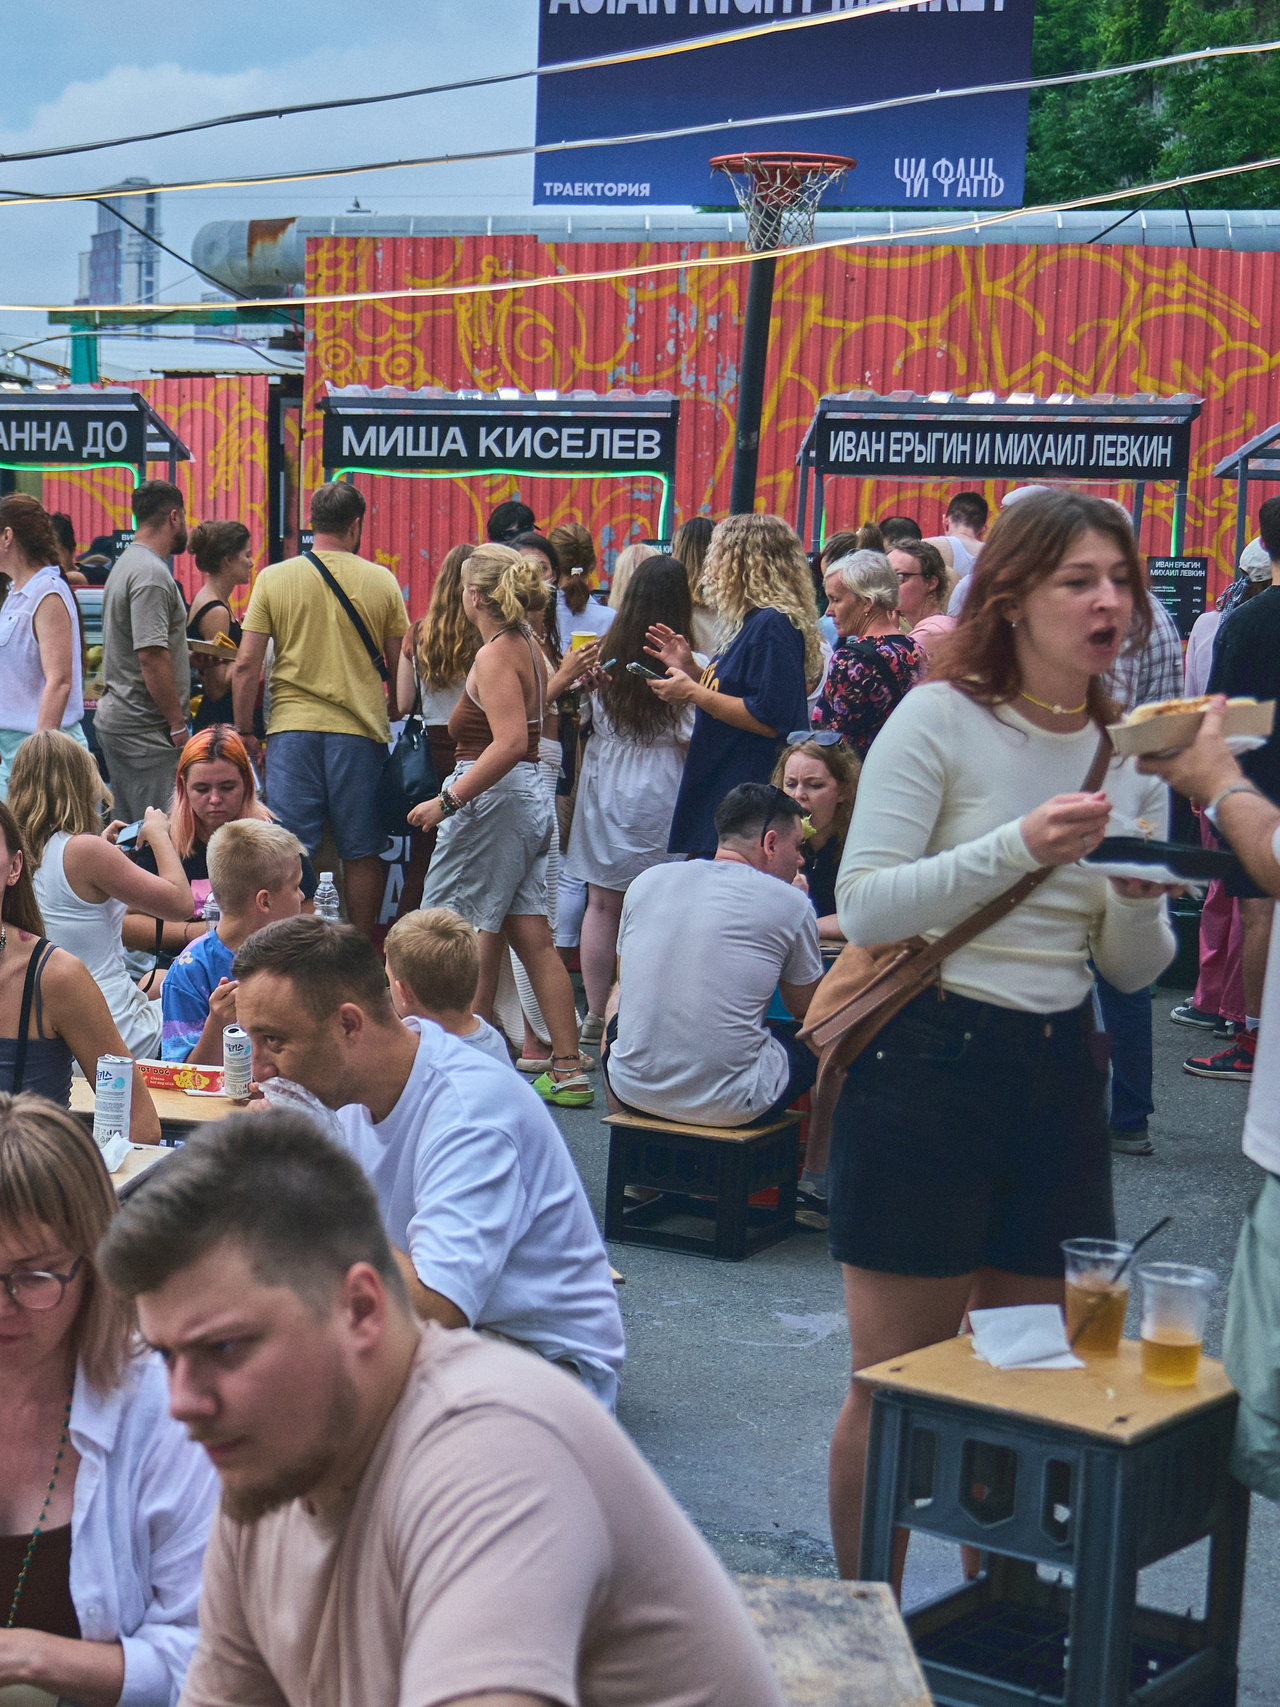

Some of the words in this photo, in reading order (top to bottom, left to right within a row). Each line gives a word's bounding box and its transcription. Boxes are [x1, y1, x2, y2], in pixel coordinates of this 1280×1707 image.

[543, 182, 651, 198] ТРАЕКТОРИЯ
[81, 421, 128, 458] ДО
[342, 425, 468, 457] МИША
[478, 426, 662, 460] КИСЕЛЕВ
[829, 430, 884, 463] ИВАН
[889, 431, 971, 464] ЕРЫГИН
[975, 433, 991, 465] И
[994, 433, 1086, 466] МИХАИЛ
[1089, 434, 1173, 468] ЛЕВКИН
[1174, 561, 1201, 569] ЕРЫГИН
